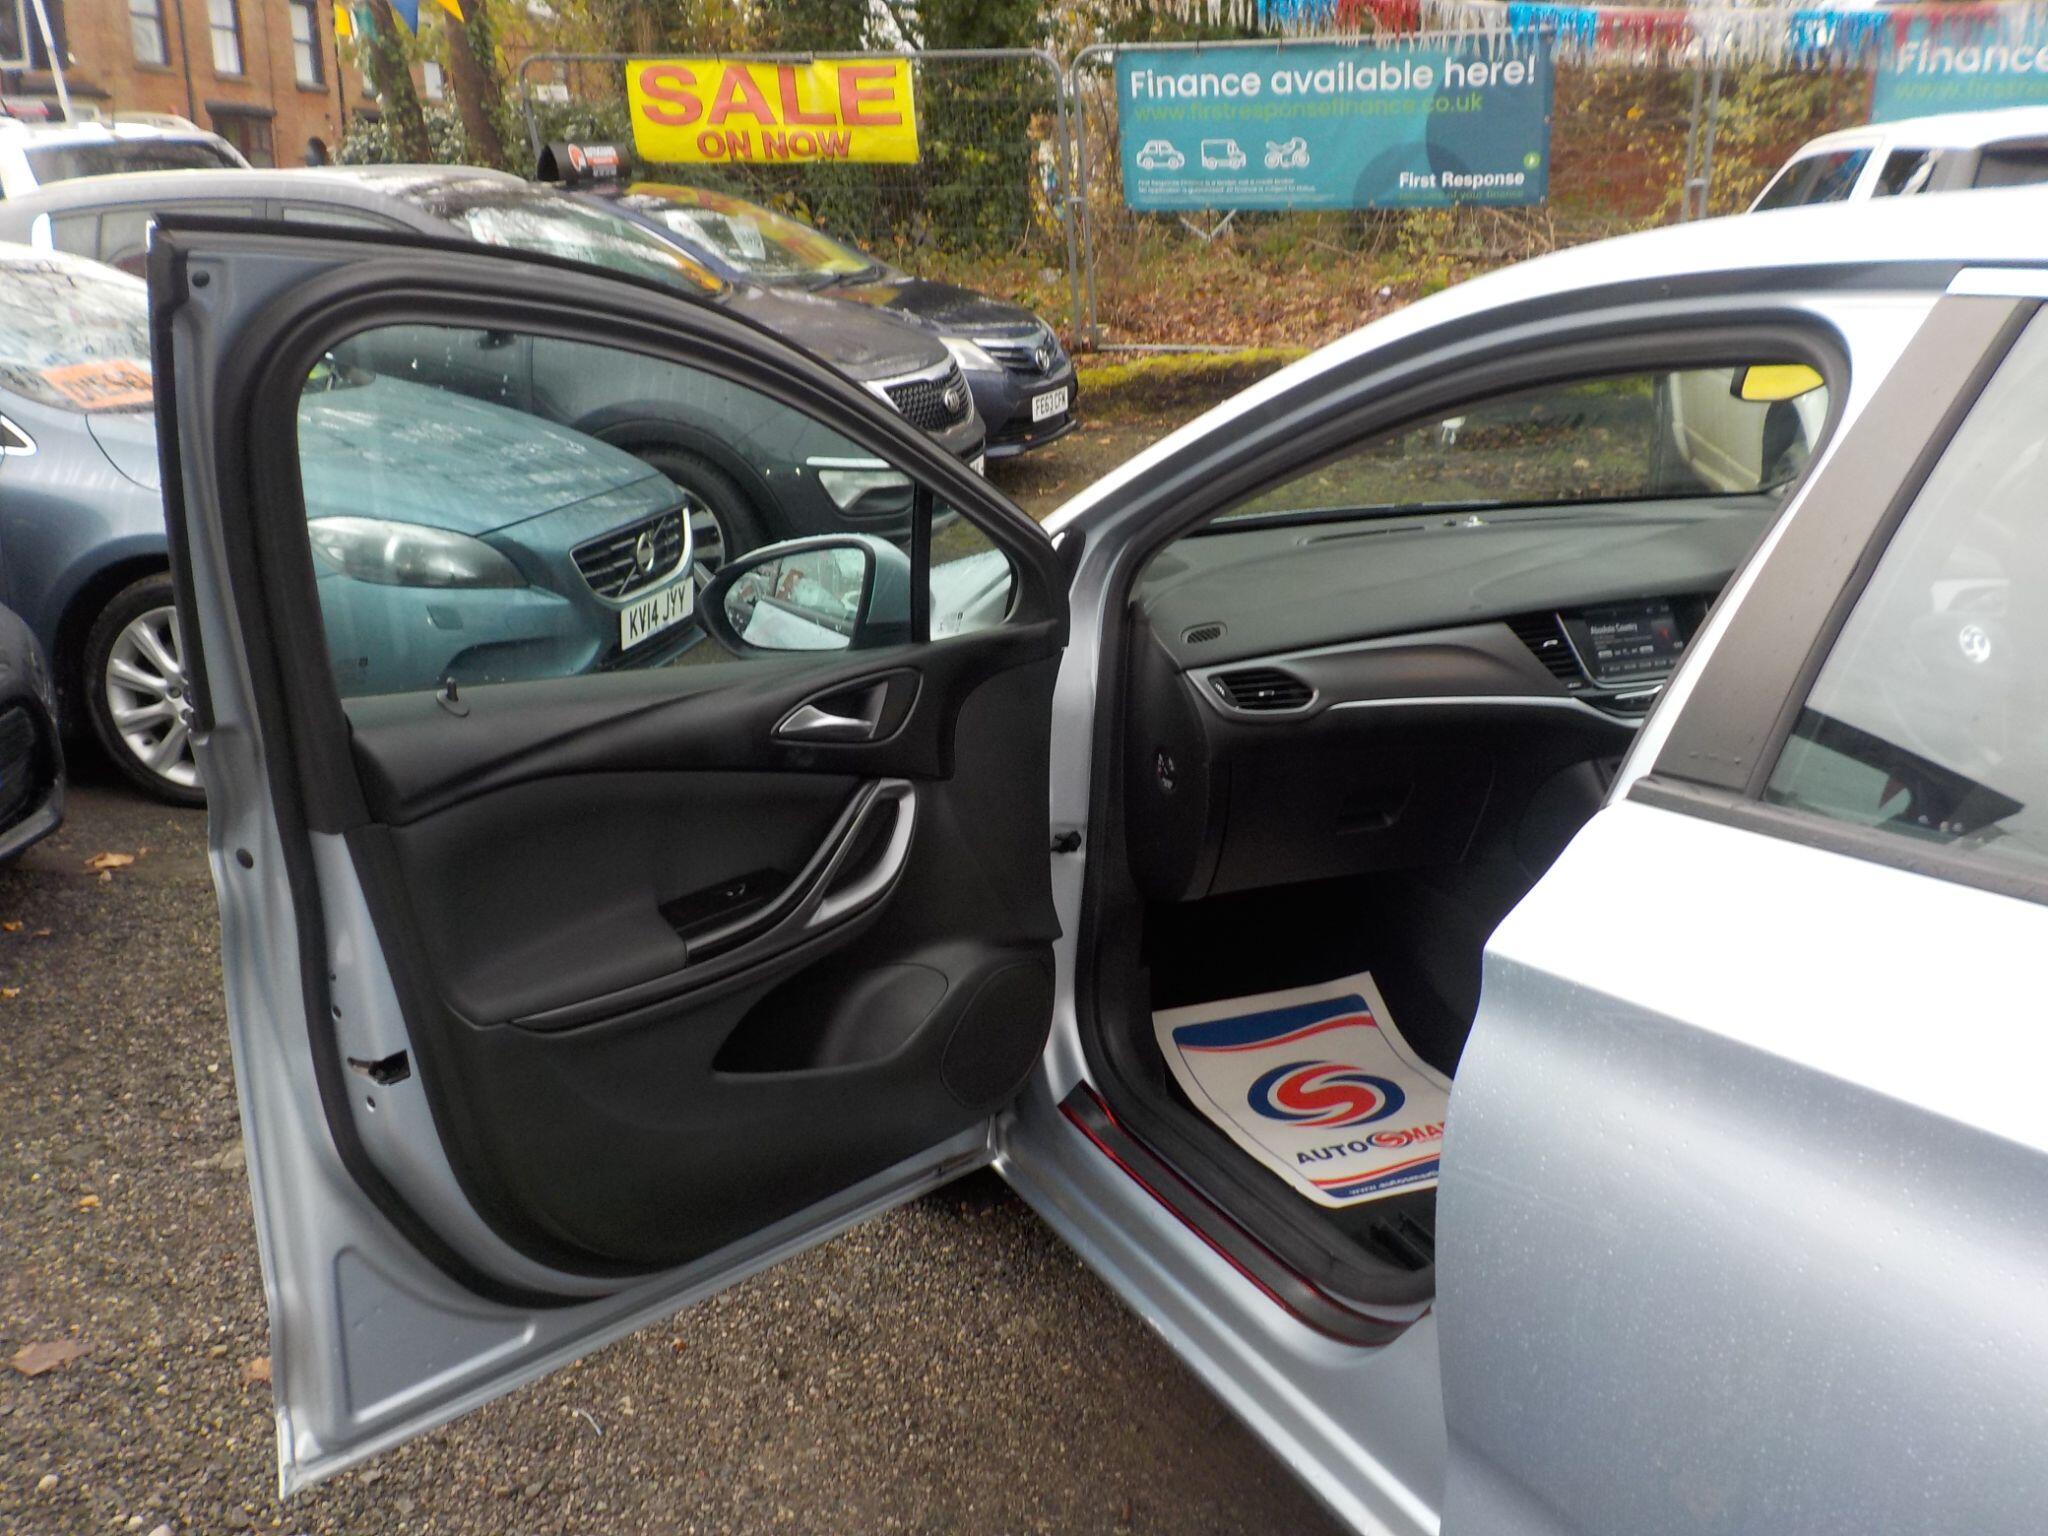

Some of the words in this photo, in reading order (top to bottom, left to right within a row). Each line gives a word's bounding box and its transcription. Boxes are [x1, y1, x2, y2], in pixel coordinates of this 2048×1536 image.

[639, 65, 902, 126] SALE
[1130, 69, 1261, 99] Finance
[1270, 60, 1434, 97] available
[1444, 57, 1537, 88] here!
[697, 130, 751, 159] ON
[760, 130, 851, 159] NOW
[1399, 172, 1437, 188] First
[1441, 171, 1526, 190] Response
[629, 599, 658, 640] KV14
[662, 585, 686, 622] JYY
[1296, 1140, 1369, 1164] AUTO
